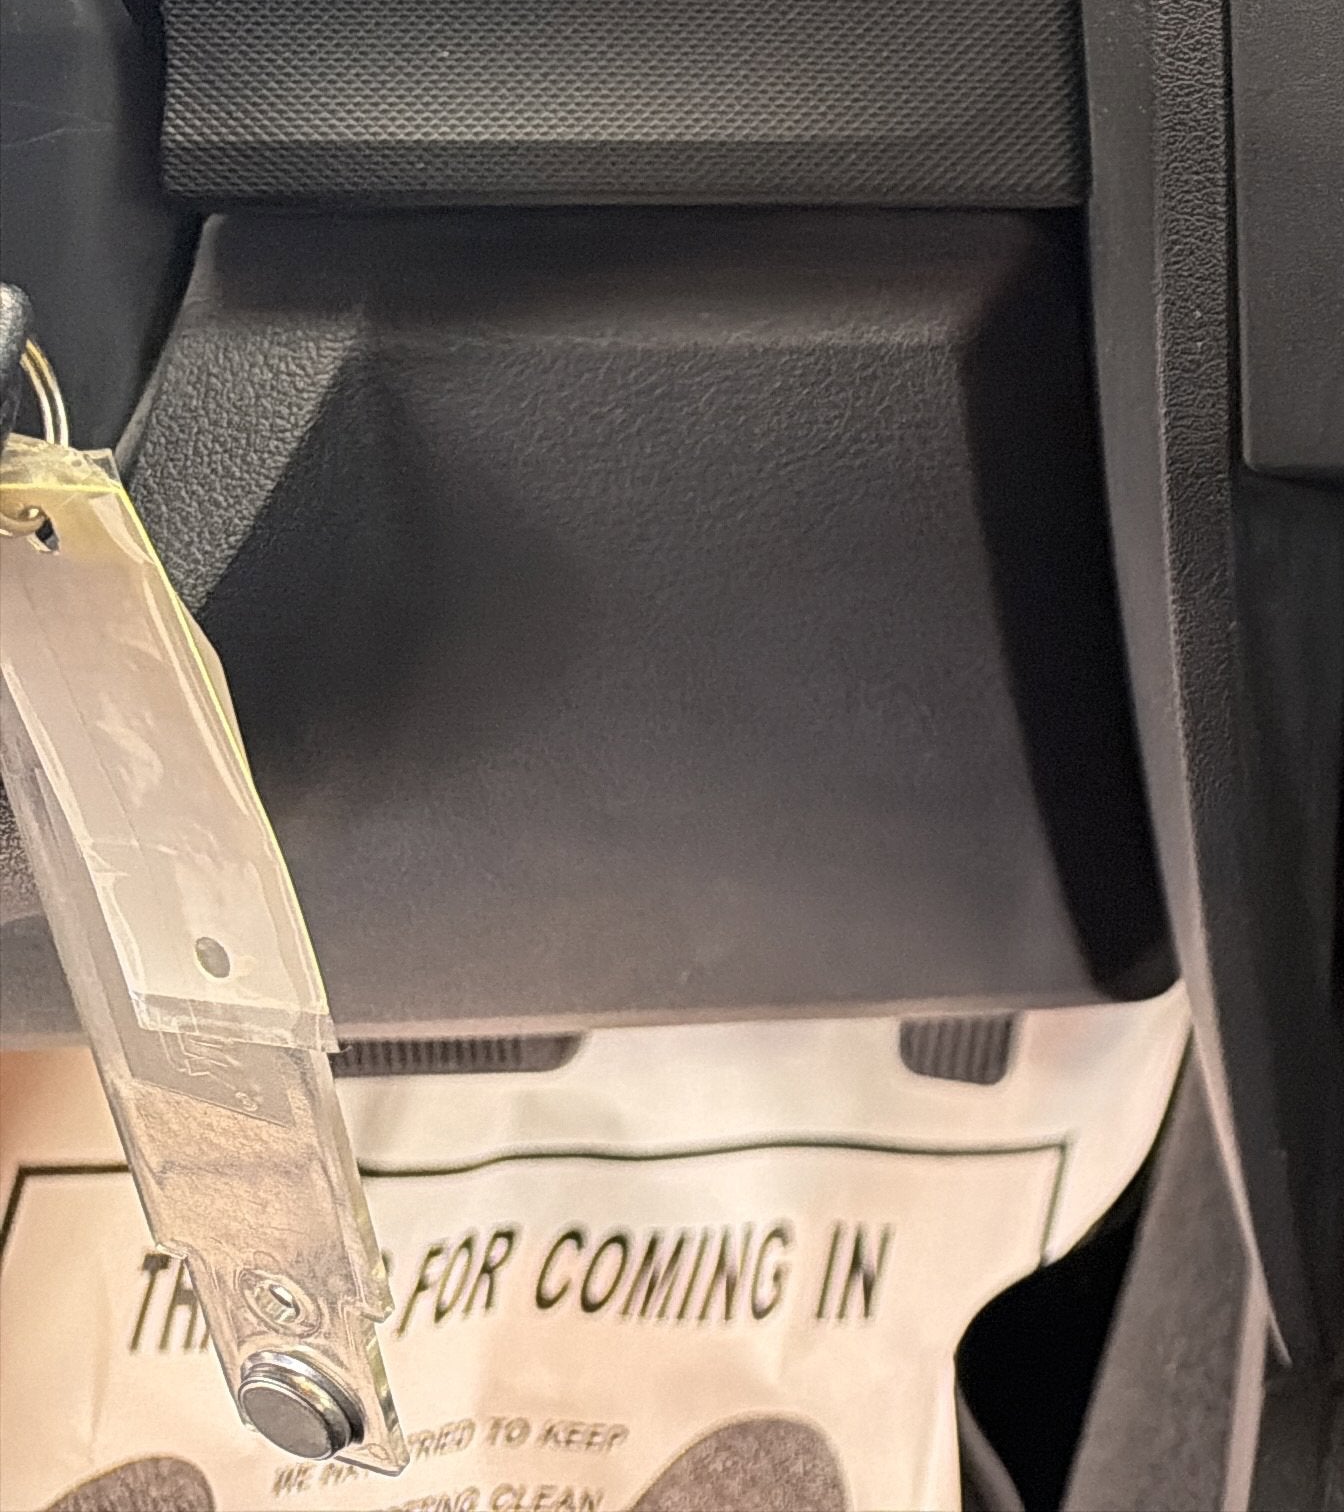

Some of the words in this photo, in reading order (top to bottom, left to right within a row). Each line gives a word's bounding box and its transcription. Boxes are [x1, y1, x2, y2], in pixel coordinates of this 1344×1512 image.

[398, 1229, 516, 1338] FOR
[535, 1223, 794, 1322] COMING
[816, 1221, 893, 1320] IN
[486, 1415, 530, 1450] TO
[537, 1419, 629, 1456] KEEP
